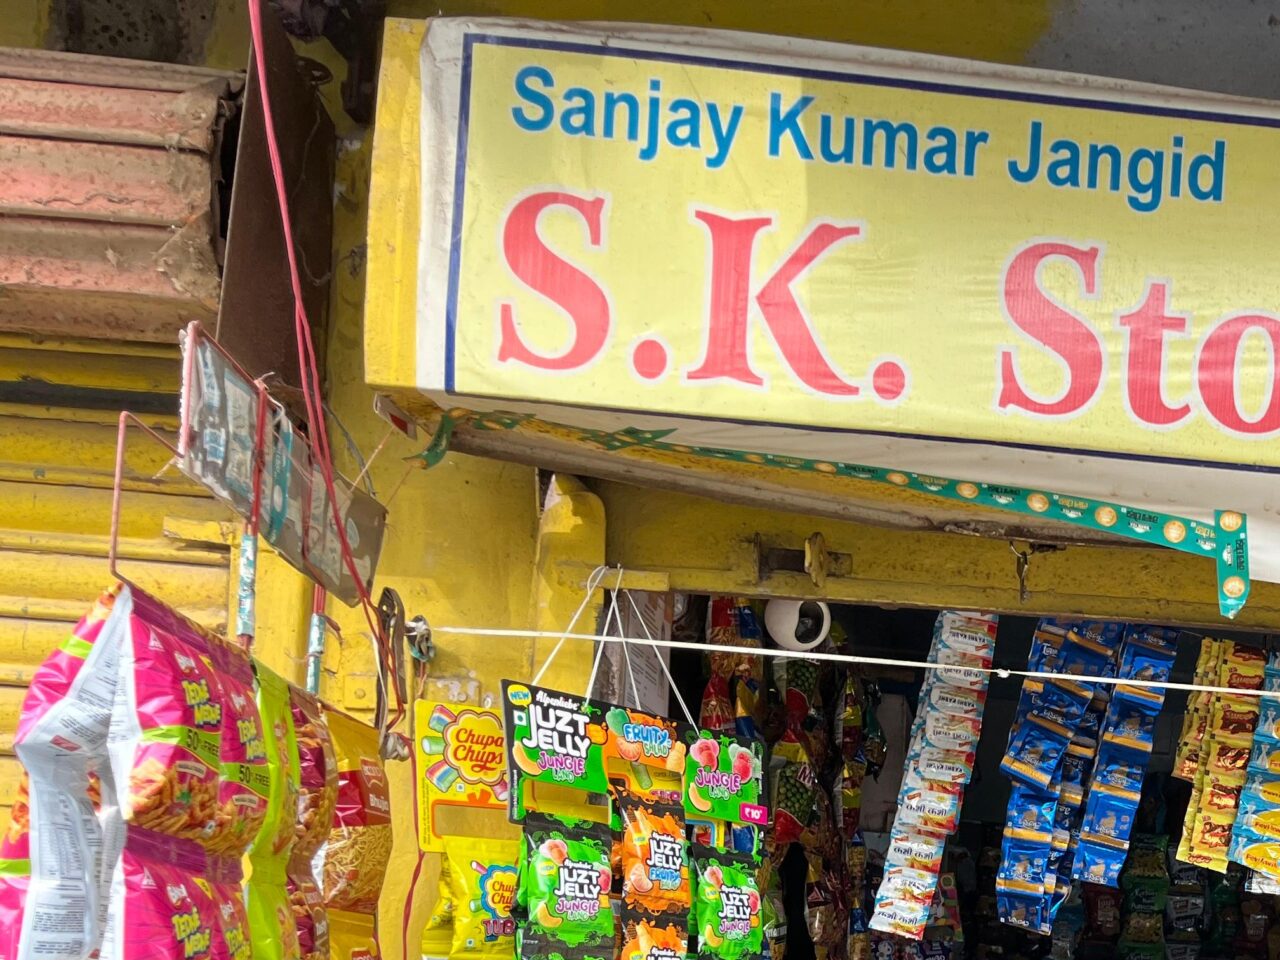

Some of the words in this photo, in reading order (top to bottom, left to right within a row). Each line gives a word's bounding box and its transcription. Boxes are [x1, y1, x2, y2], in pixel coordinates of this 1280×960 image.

[511, 65, 743, 169] Sanjay
[767, 91, 988, 178] Kumar
[1008, 120, 1225, 211] Jangid
[498, 190, 908, 401] S.K.
[510, 691, 529, 701] NEW
[536, 690, 579, 709] Alpenliebe
[527, 704, 590, 735] JUZT
[455, 728, 504, 748] Chupa
[522, 730, 591, 758] JELLY
[623, 723, 671, 747] FRUITY
[453, 745, 503, 772] Chups
[537, 752, 585, 774] JUNGLE
[695, 768, 741, 793] JUNGLE
[650, 839, 682, 856] JUZT
[647, 852, 682, 869] JELLY
[558, 866, 599, 885] JUZT
[554, 882, 600, 899] JELLY
[719, 903, 750, 918] JELLY
